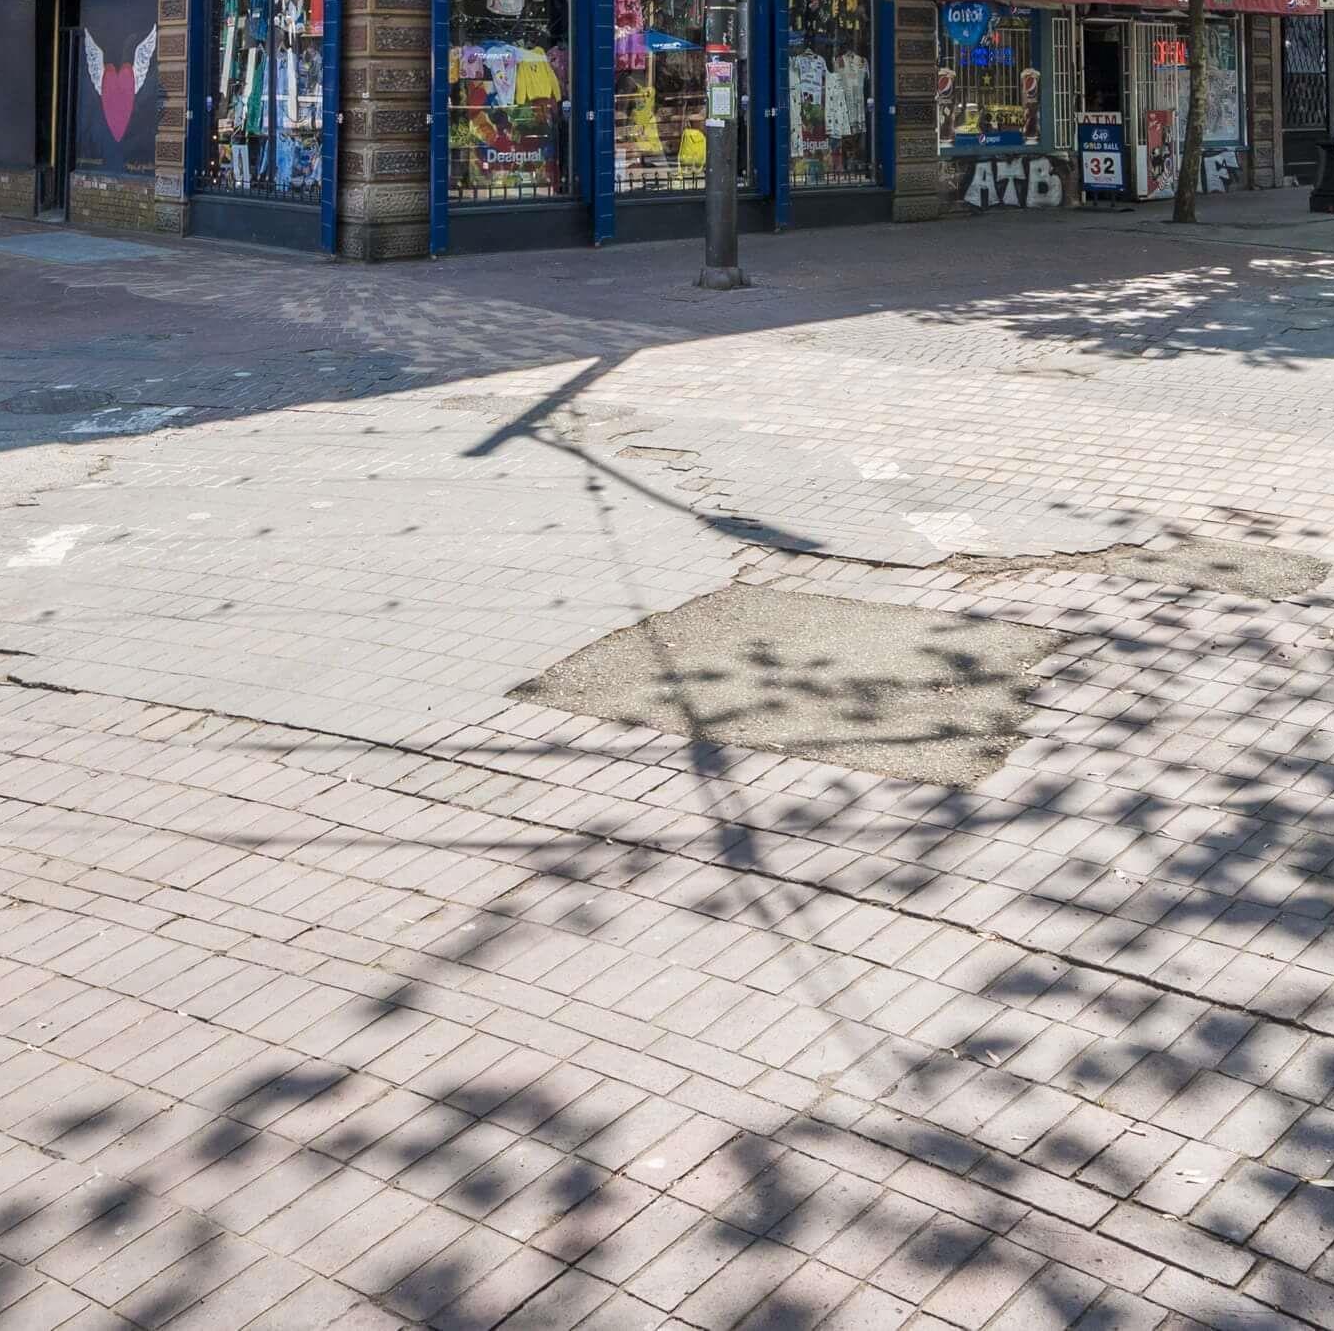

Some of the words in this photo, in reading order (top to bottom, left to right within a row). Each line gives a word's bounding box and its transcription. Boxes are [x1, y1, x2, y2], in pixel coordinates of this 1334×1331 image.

[1091, 128, 1109, 141] 649
[1083, 142, 1103, 150] GOLD
[1103, 142, 1119, 151] BALL
[487, 148, 542, 165] Desigual
[1090, 158, 1116, 175] 32
